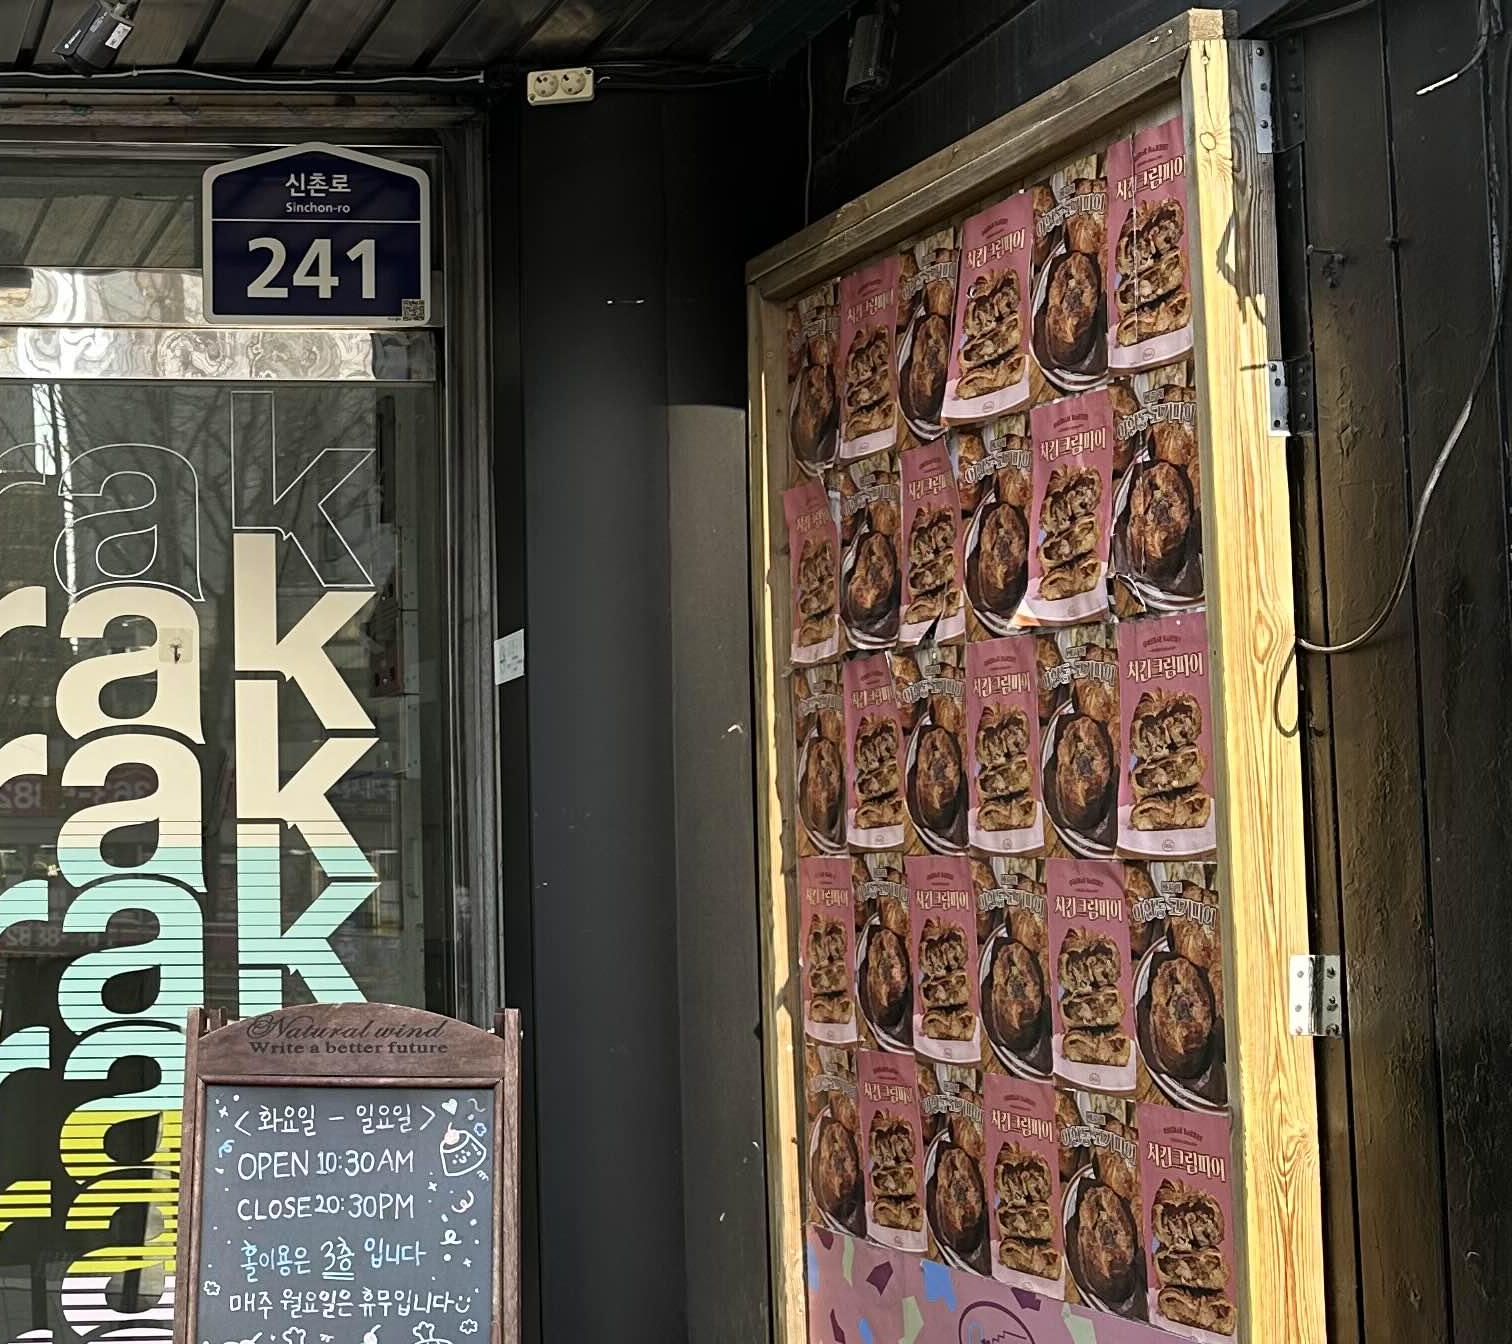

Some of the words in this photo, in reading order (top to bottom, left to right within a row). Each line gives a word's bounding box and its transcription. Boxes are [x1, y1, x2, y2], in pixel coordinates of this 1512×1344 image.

[285, 173, 352, 197] 신촌로
[285, 202, 351, 214] Sinchon-ro
[246, 237, 376, 299] 241
[247, 1014, 374, 1039] Natural
[375, 1020, 449, 1039] wind
[249, 1041, 306, 1055] Write
[310, 1044, 320, 1054] a
[326, 1041, 383, 1055] better
[388, 1041, 449, 1055] future
[257, 1104, 317, 1136] 화요일
[355, 1104, 412, 1134] 일요일
[237, 1150, 310, 1181] OPEN
[237, 1196, 313, 1221] CLOSE
[240, 1239, 312, 1283] 홀이용은
[320, 1236, 356, 1273] 3층
[364, 1237, 427, 1269] 입니다
[229, 1290, 274, 1320] 매주
[280, 1287, 355, 1319] 월요일은
[358, 1285, 455, 1317] 휴무입니다
